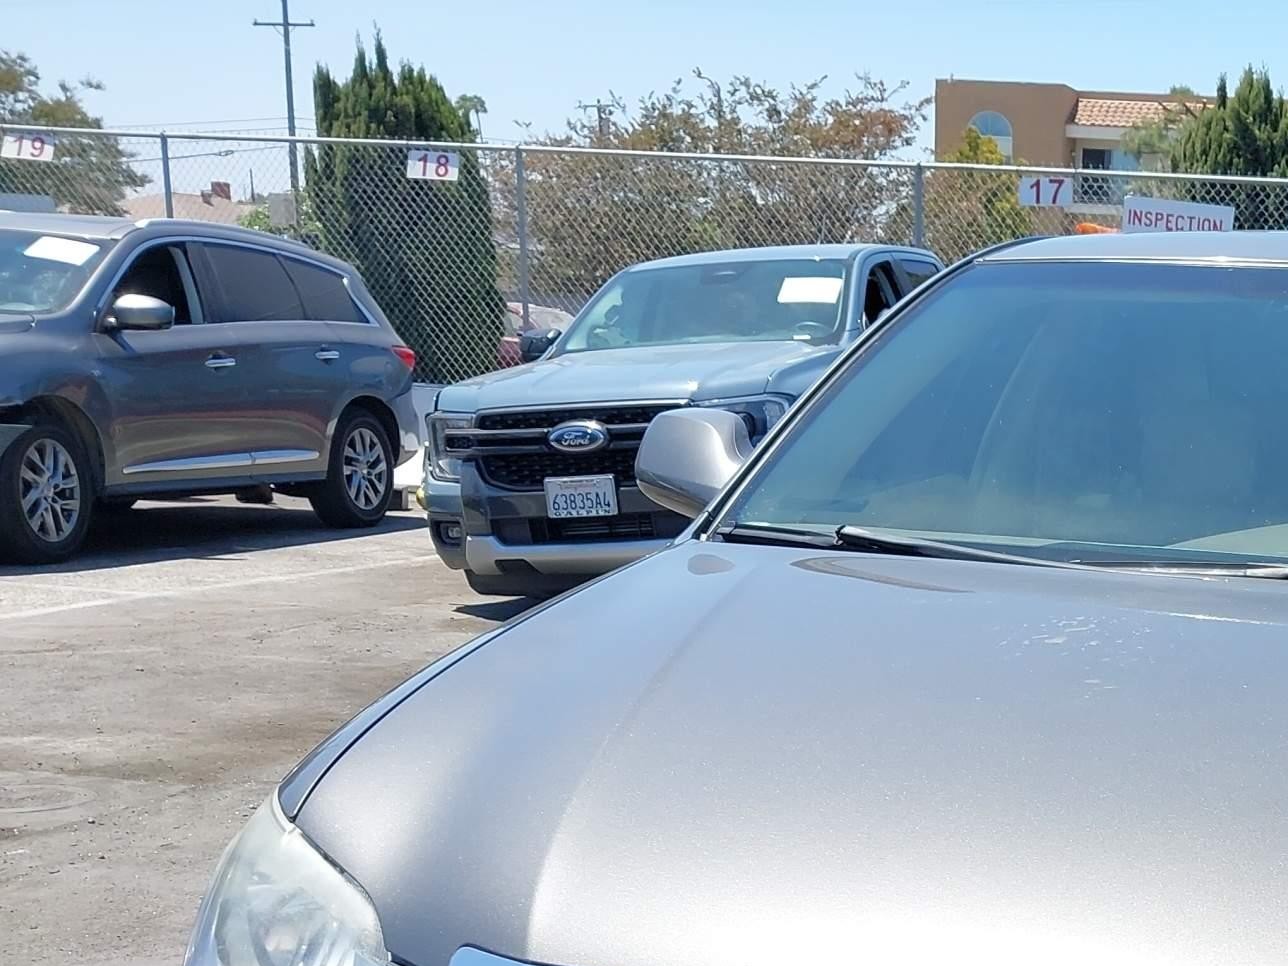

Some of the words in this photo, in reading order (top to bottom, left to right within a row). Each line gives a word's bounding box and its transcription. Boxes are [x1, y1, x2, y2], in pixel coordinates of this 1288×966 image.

[14, 135, 45, 157] 19
[418, 153, 449, 177] 18
[1029, 178, 1065, 205] 17
[1127, 208, 1224, 232] INSPECTION
[561, 431, 592, 446] Ford
[552, 491, 611, 511] 63835A4
